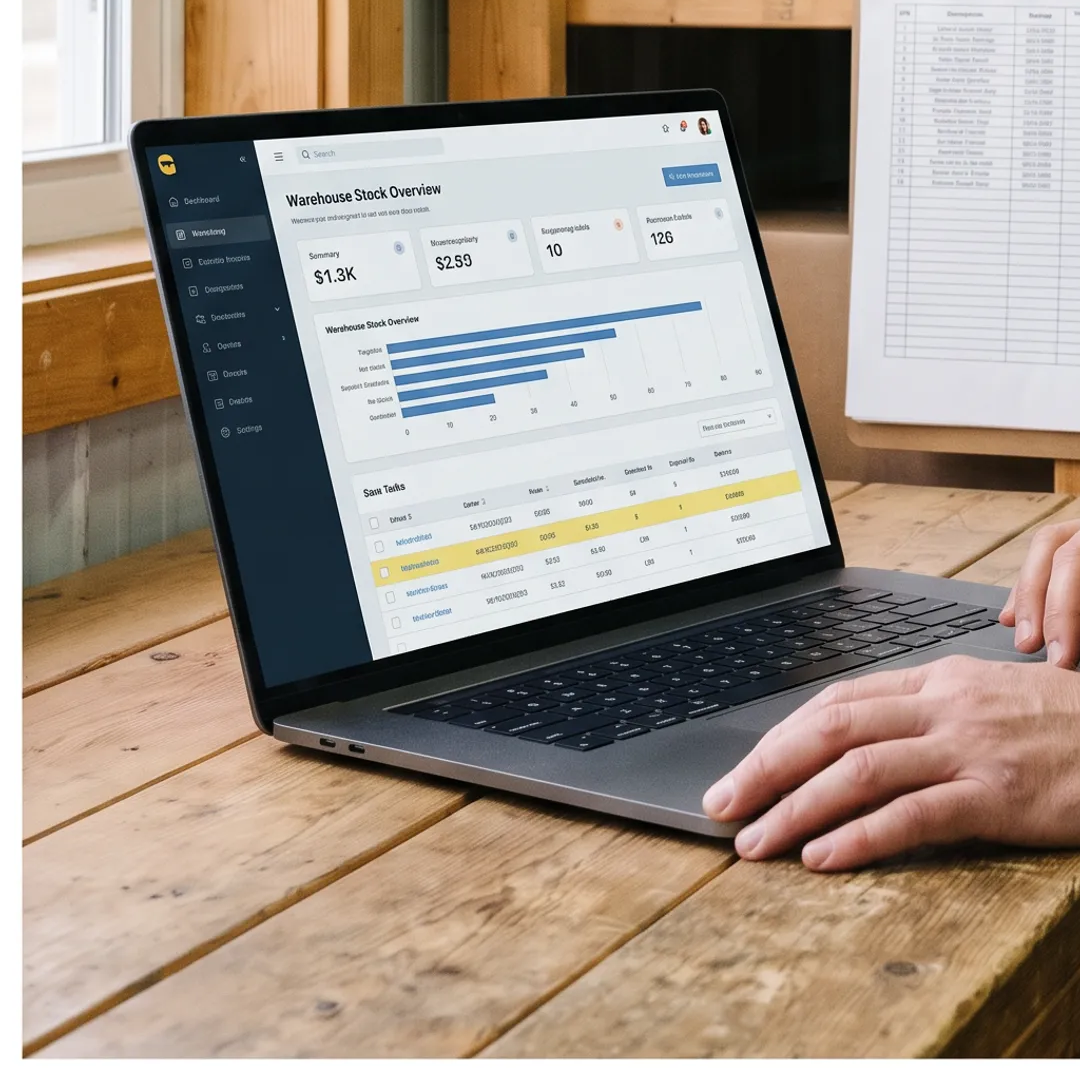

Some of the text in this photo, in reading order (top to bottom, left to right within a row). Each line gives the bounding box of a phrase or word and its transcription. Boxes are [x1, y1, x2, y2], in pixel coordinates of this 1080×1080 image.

[313, 150, 336, 159] Search
[286, 183, 442, 208] Warehouse Stock Overview
[650, 230, 674, 246] 126
[546, 242, 563, 258] 10
[314, 266, 357, 286] $1.3K
[366, 318, 387, 330] Stock
[388, 315, 420, 328] Overview
[446, 421, 454, 429] 10
[489, 414, 497, 422] 20
